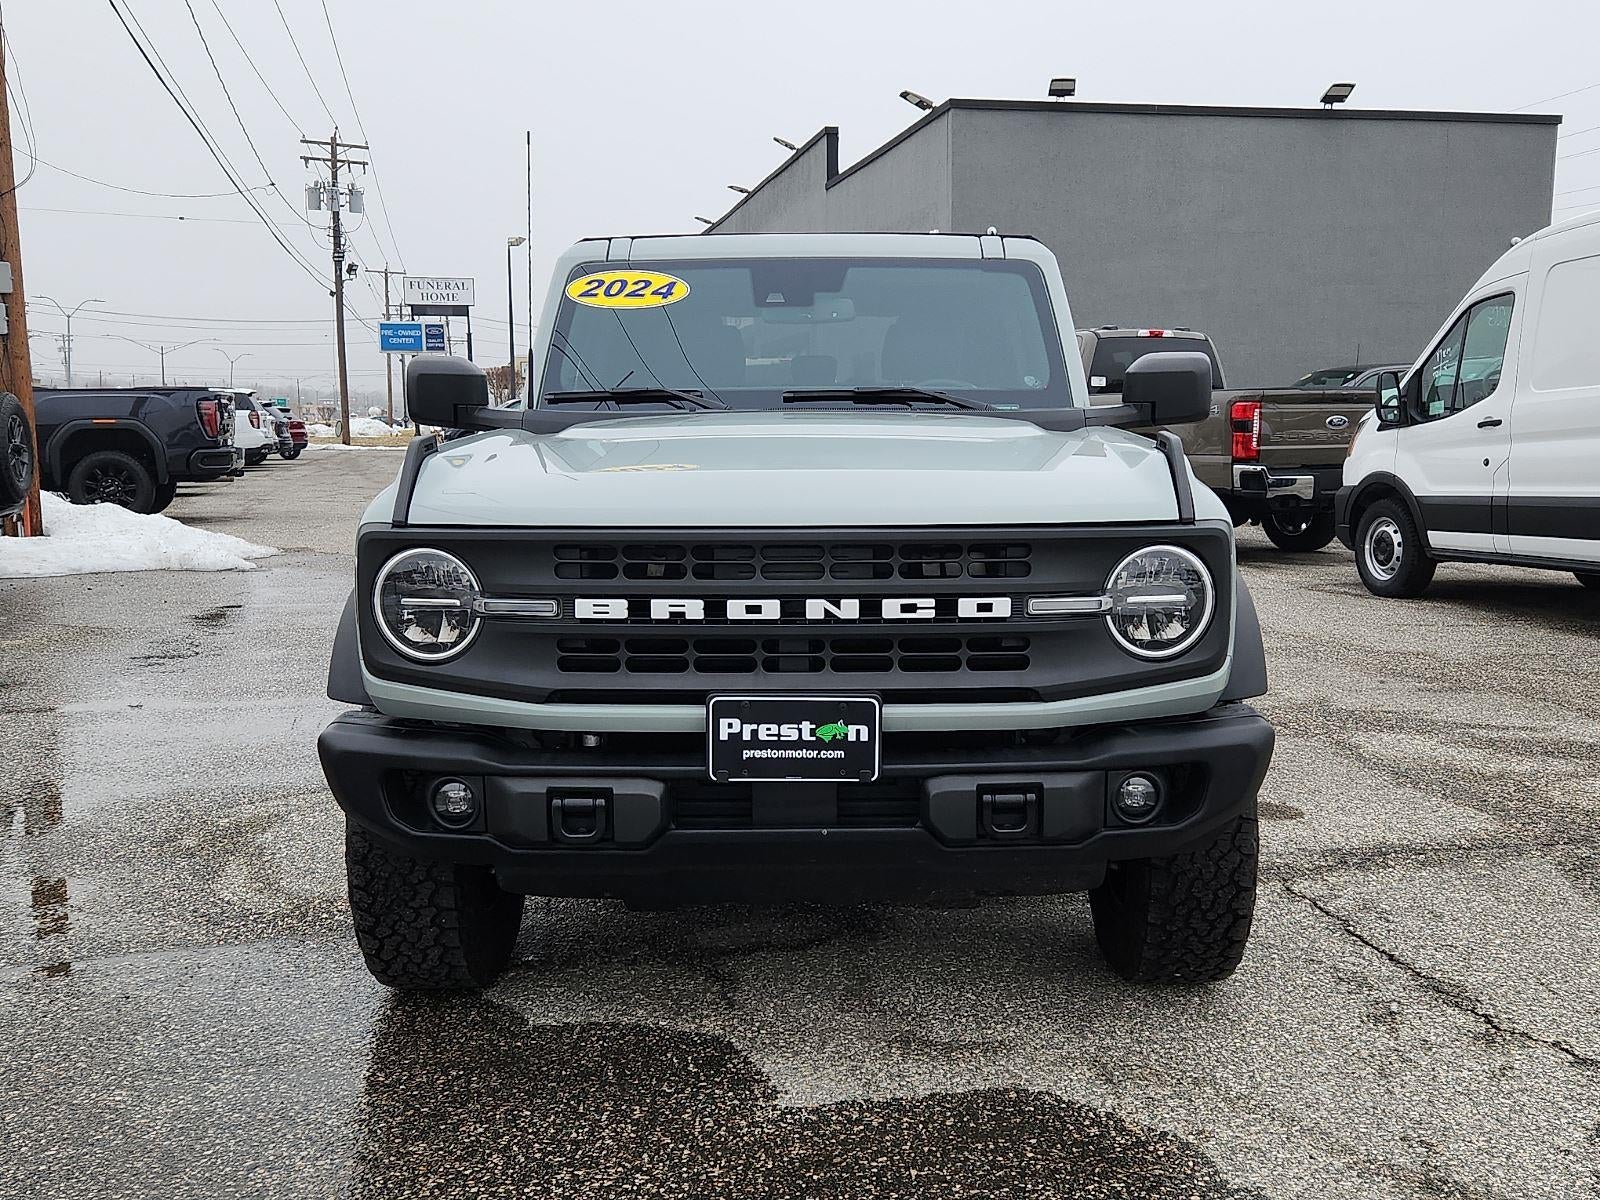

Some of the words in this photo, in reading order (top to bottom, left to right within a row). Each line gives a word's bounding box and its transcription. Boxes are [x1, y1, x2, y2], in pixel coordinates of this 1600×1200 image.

[409, 281, 469, 290] FUNERAL
[577, 279, 678, 299] 2024
[421, 293, 459, 301] HOME
[575, 597, 1011, 620] BRONCO
[719, 718, 869, 743] Preston
[742, 749, 845, 760] prestonmotor.com
